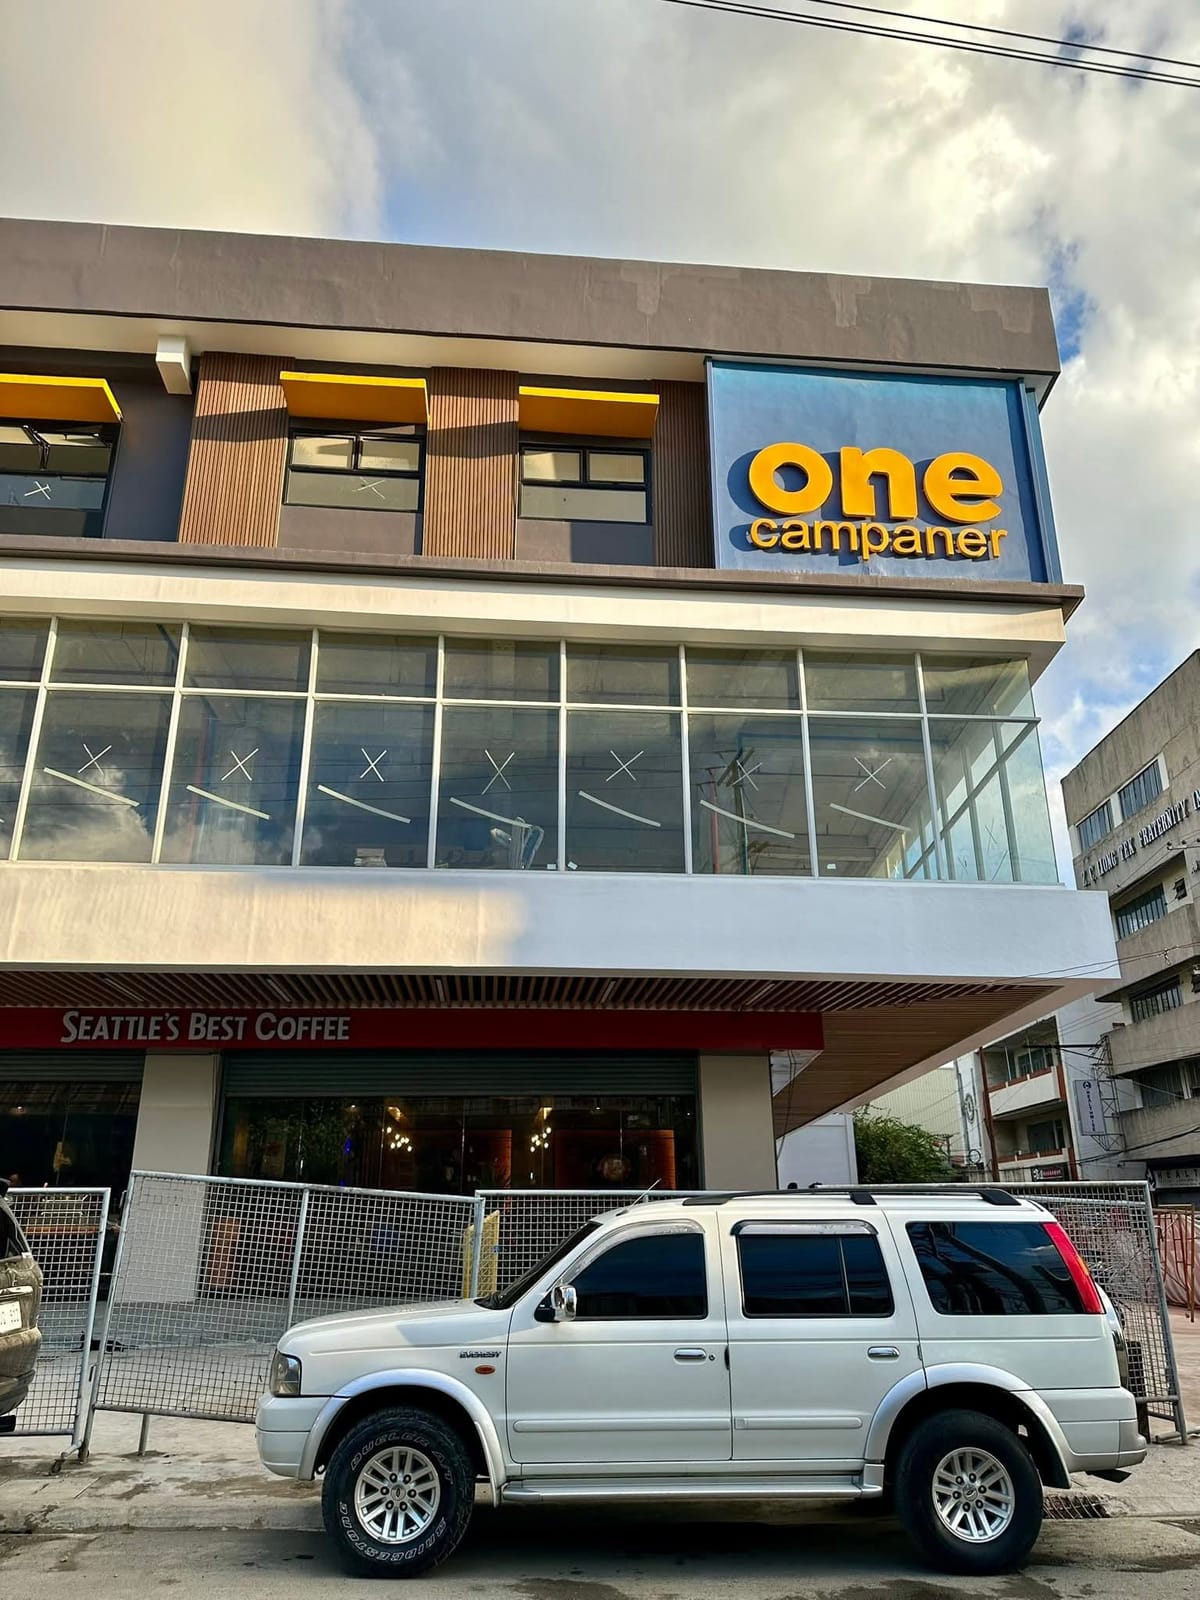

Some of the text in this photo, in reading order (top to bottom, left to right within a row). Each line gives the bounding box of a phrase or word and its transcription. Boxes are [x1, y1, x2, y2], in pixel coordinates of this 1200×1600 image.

[749, 442, 1003, 524] one
[750, 518, 1008, 561] campaner
[1138, 799, 1189, 848] FRATERNITY
[60, 1010, 351, 1043] SEATTLE'S BEST COFFEE
[350, 1432, 430, 1471] DUELER
[339, 1501, 448, 1561] BRIDGESTONE
